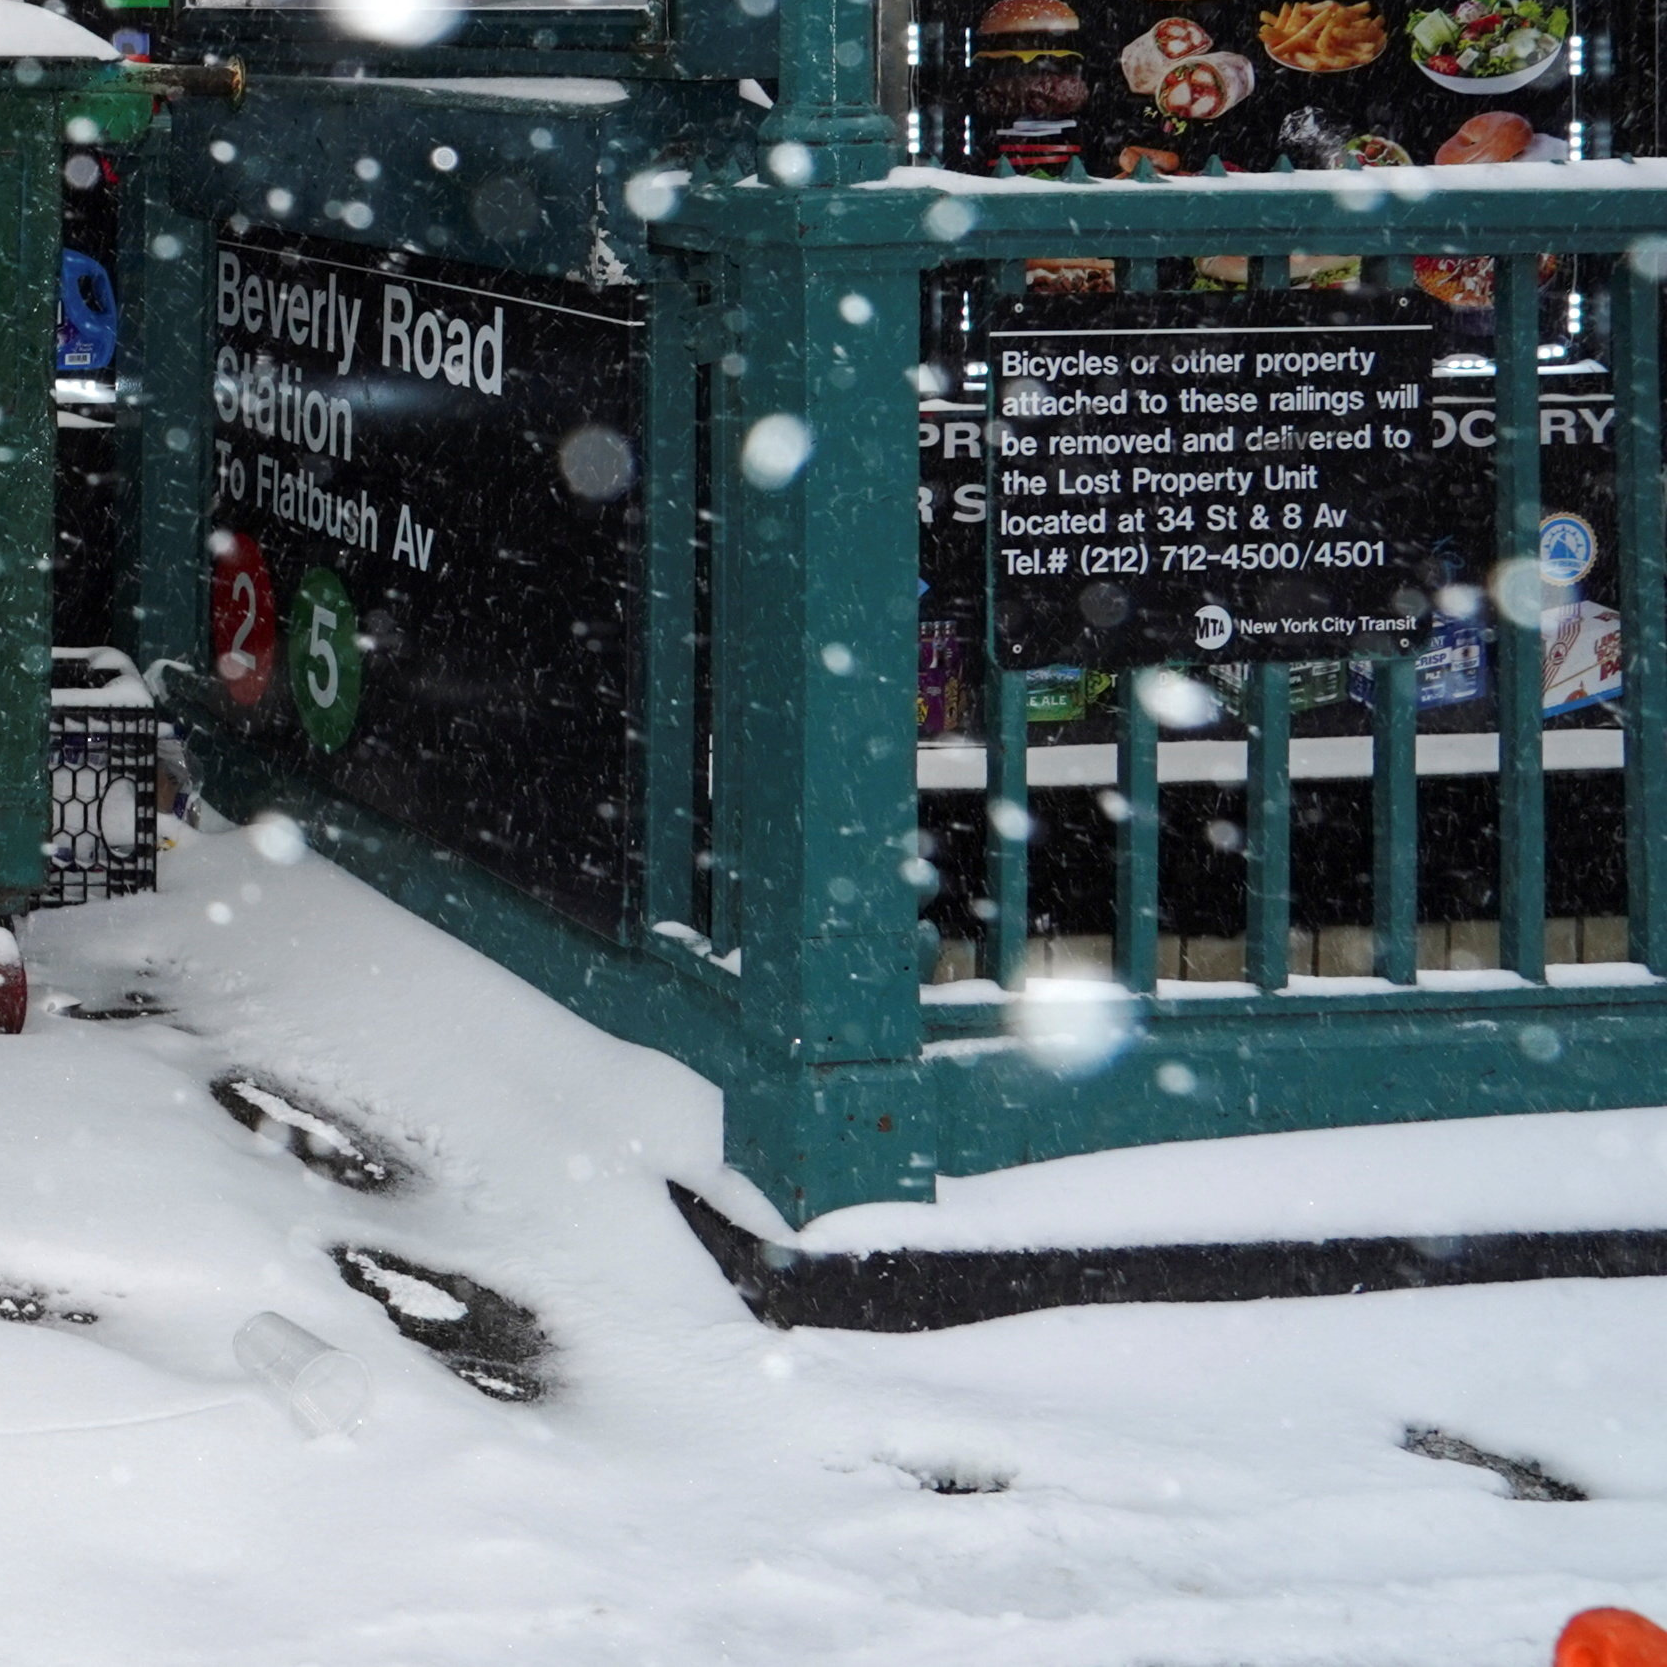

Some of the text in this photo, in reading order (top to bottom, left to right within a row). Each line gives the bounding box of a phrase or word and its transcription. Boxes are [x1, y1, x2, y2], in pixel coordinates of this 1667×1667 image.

[216, 250, 504, 396] Beverly Road
[1002, 347, 1375, 382] Bicycles or other property
[214, 345, 353, 462] Station
[1002, 382, 1419, 417] attached to these railings will
[1001, 428, 1038, 457] be
[1048, 426, 1172, 456] removed
[1181, 425, 1235, 454] and
[1244, 423, 1371, 453] delivered
[1382, 425, 1411, 450] to
[1002, 462, 1318, 499] the Lost Property Unit
[215, 441, 435, 572] To Flatbush Av
[999, 502, 1348, 537] located at 34 St & 8 Av
[1002, 539, 1387, 578] Tel.# (212) 712-4500/4501
[231, 572, 339, 709] 2 5
[1195, 614, 1417, 641] MTA New York City Transit
[1040, 695, 1067, 707] ALE
